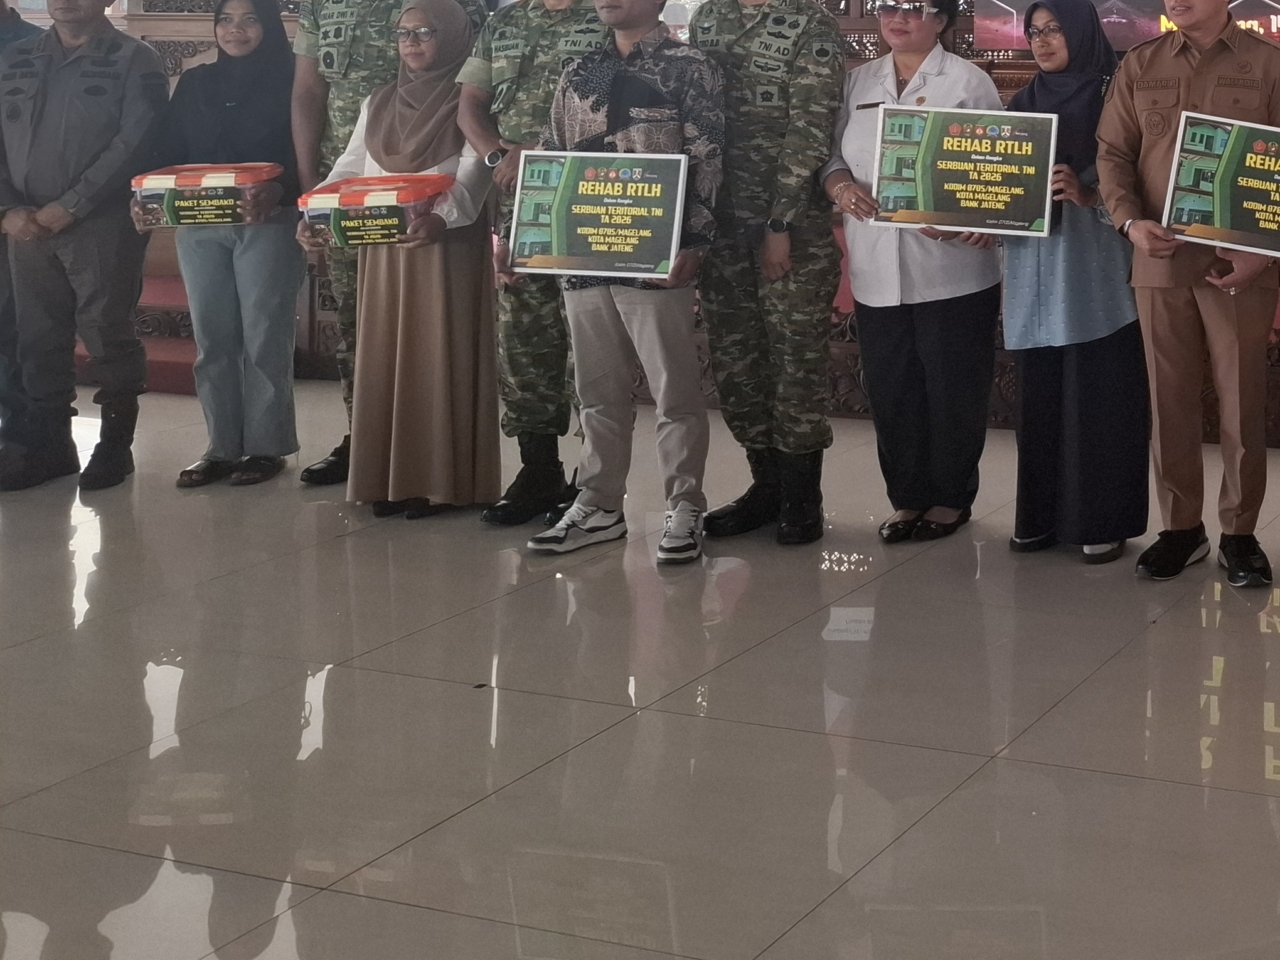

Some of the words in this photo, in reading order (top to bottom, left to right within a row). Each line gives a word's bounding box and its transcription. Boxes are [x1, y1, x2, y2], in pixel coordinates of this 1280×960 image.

[564, 39, 582, 48] TNI
[585, 40, 603, 50] AD
[757, 41, 773, 52] TNI
[774, 45, 791, 57] AD
[943, 137, 991, 152] REHAB
[996, 140, 1032, 154] RTLH
[937, 161, 974, 171] SERBUAN
[976, 163, 1020, 173] TERITORIAL
[1022, 165, 1035, 174] TNI
[969, 172, 978, 180] TA
[980, 173, 1001, 181] 2026
[578, 181, 623, 195] REHAB
[627, 183, 661, 197] RTLH
[944, 183, 965, 191] KODIM
[1237, 177, 1276, 191] SERBUAN
[975, 193, 1010, 202] MAGELANG
[1270, 191, 1280, 201] TA
[174, 199, 198, 207] PAKET
[199, 198, 234, 206] SEMBAKO
[961, 200, 978, 208] BANK
[980, 201, 1005, 209] JATENG
[1243, 201, 1266, 211] KODIM
[571, 205, 606, 214] SERBUAN
[608, 206, 649, 216] TERITORIAL
[651, 208, 663, 216] TNI
[601, 215, 609, 223] TA
[611, 216, 631, 224] 2026
[1255, 211, 1273, 221] KOTA
[341, 219, 363, 227] PAKET
[364, 217, 399, 226] SEMBAKO
[1259, 220, 1278, 231] BANK
[577, 227, 597, 235] KODIM
